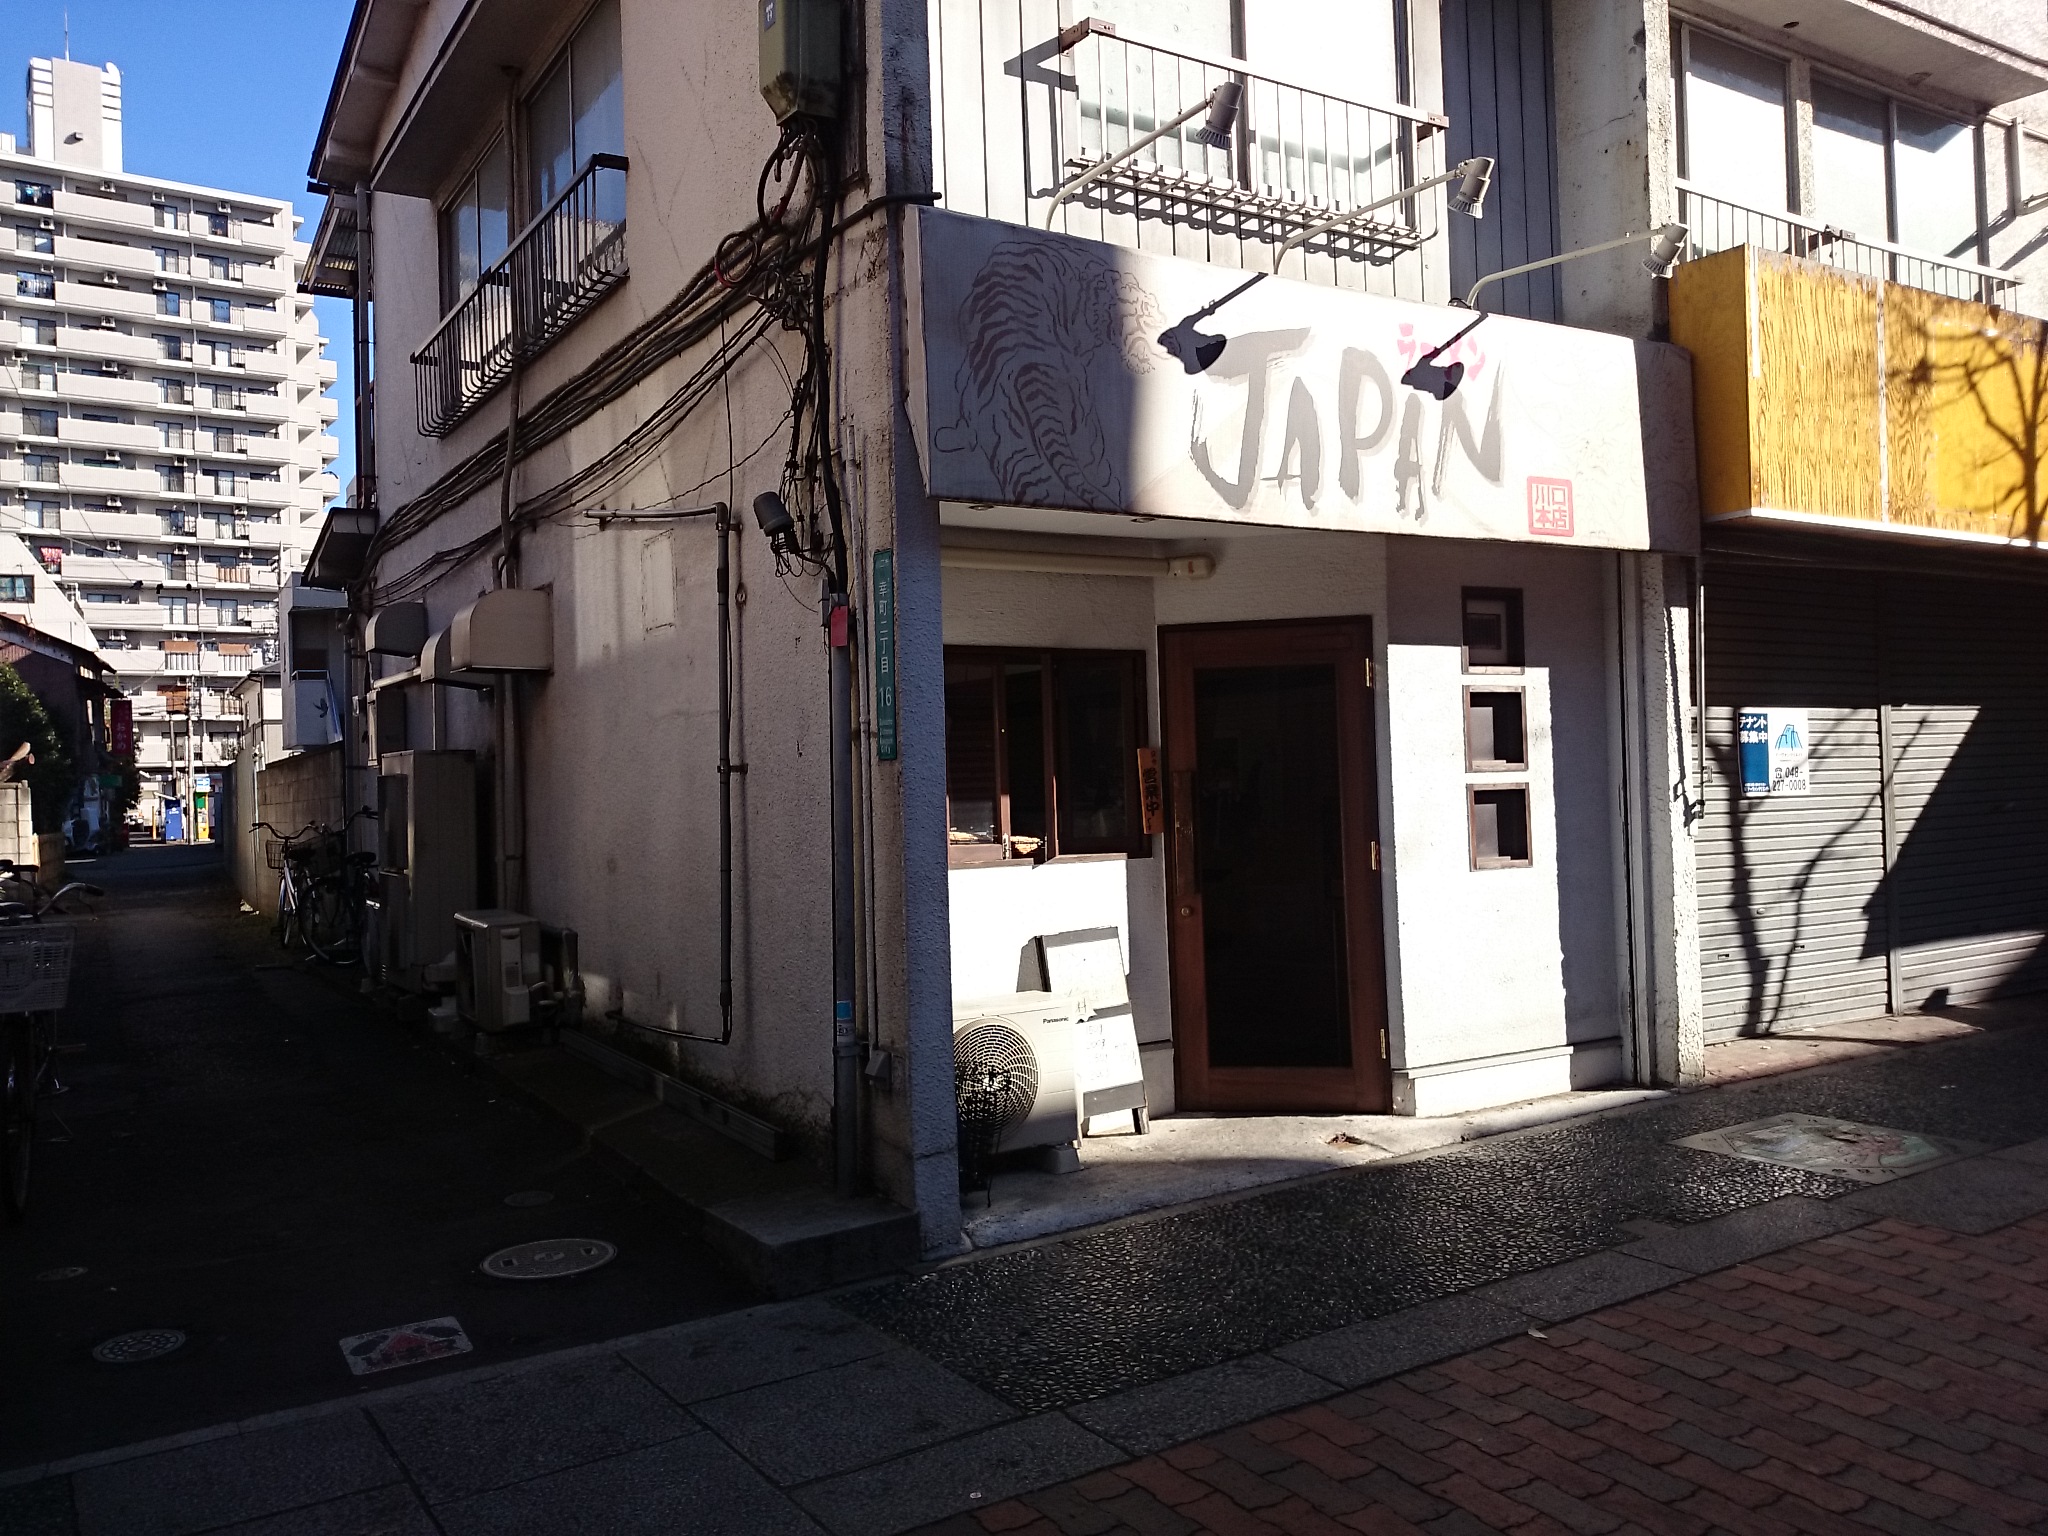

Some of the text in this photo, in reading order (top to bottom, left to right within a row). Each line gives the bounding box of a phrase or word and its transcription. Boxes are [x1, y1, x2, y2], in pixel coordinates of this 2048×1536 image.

[1190, 327, 1507, 520] JAPAN
[1535, 484, 1567, 506] 川口
[1535, 505, 1568, 529] 本店
[879, 686, 893, 707] 16
[1739, 716, 1767, 729] テナント
[1740, 730, 1769, 744] 募集中
[1042, 1016, 1070, 1025] Panasonic
